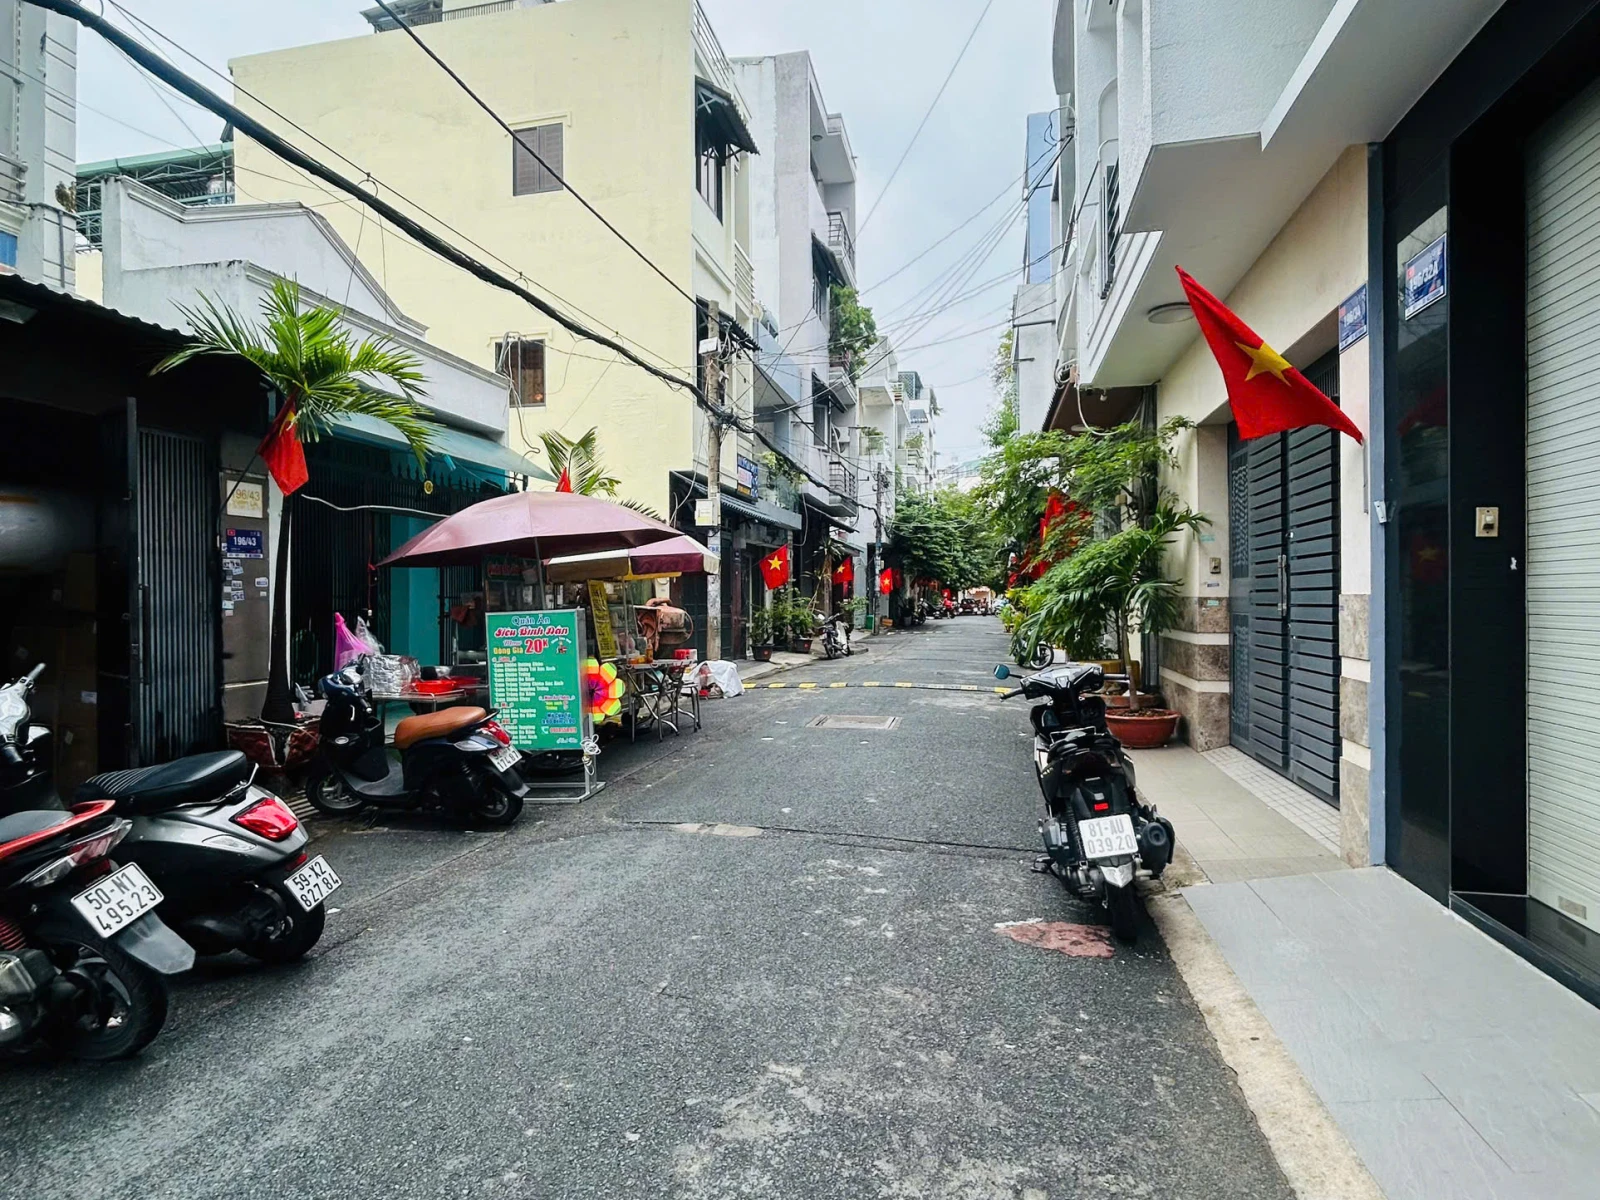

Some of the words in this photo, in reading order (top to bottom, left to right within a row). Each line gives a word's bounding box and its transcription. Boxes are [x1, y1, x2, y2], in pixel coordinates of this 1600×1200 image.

[233, 537, 256, 546] 196/43
[1088, 818, 1125, 838] 81-AU
[1088, 835, 1134, 854] 039.20
[292, 862, 328, 890] 59-X2
[300, 872, 341, 908] 827.84
[84, 872, 139, 912] 50-N1
[95, 885, 158, 932] 495.23
